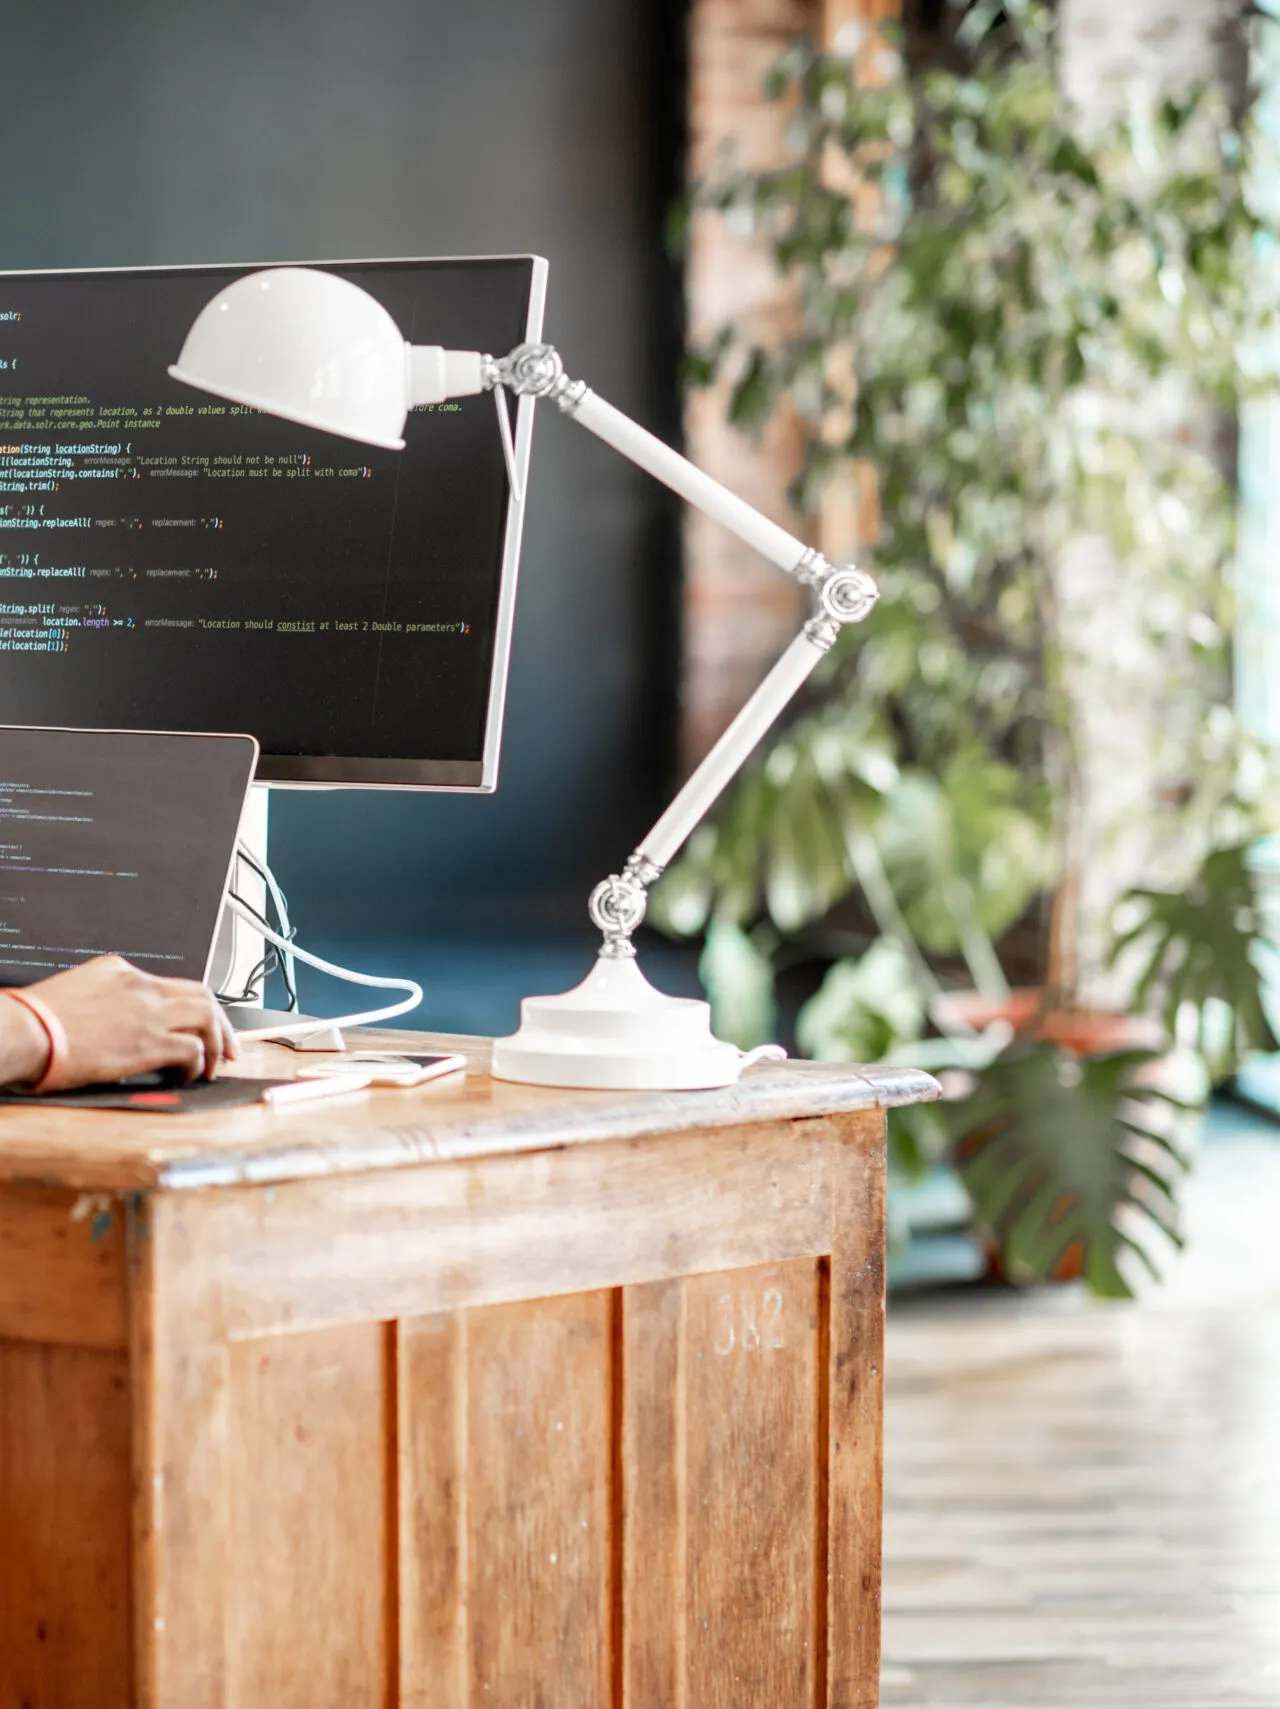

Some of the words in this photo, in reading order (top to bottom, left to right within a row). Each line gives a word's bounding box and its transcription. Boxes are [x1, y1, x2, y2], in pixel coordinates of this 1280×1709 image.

[25, 395, 90, 407] representation.
[438, 402, 463, 412] coma.
[28, 407, 46, 416] that
[50, 407, 94, 418] represents
[99, 406, 138, 417] location,
[143, 408, 152, 416] as
[166, 406, 193, 415] double
[198, 405, 225, 415] values
[230, 404, 253, 416] split
[124, 420, 161, 428] instance
[55, 443, 121, 455] locationString)
[136, 456, 177, 465] "Location
[181, 455, 209, 467] String
[213, 455, 241, 465] should
[245, 456, 260, 465] not
[264, 455, 274, 465] be
[203, 467, 245, 477] "Location
[248, 468, 268, 477] must
[272, 467, 283, 477] be
[286, 467, 310, 479] split
[314, 467, 334, 477] with
[43, 616, 109, 628] location.length
[198, 618, 240, 629] "Location
[244, 619, 273, 629] should
[277, 620, 315, 632] constist
[320, 621, 330, 630] at
[335, 621, 358, 631] least
[372, 621, 402, 631] Double
